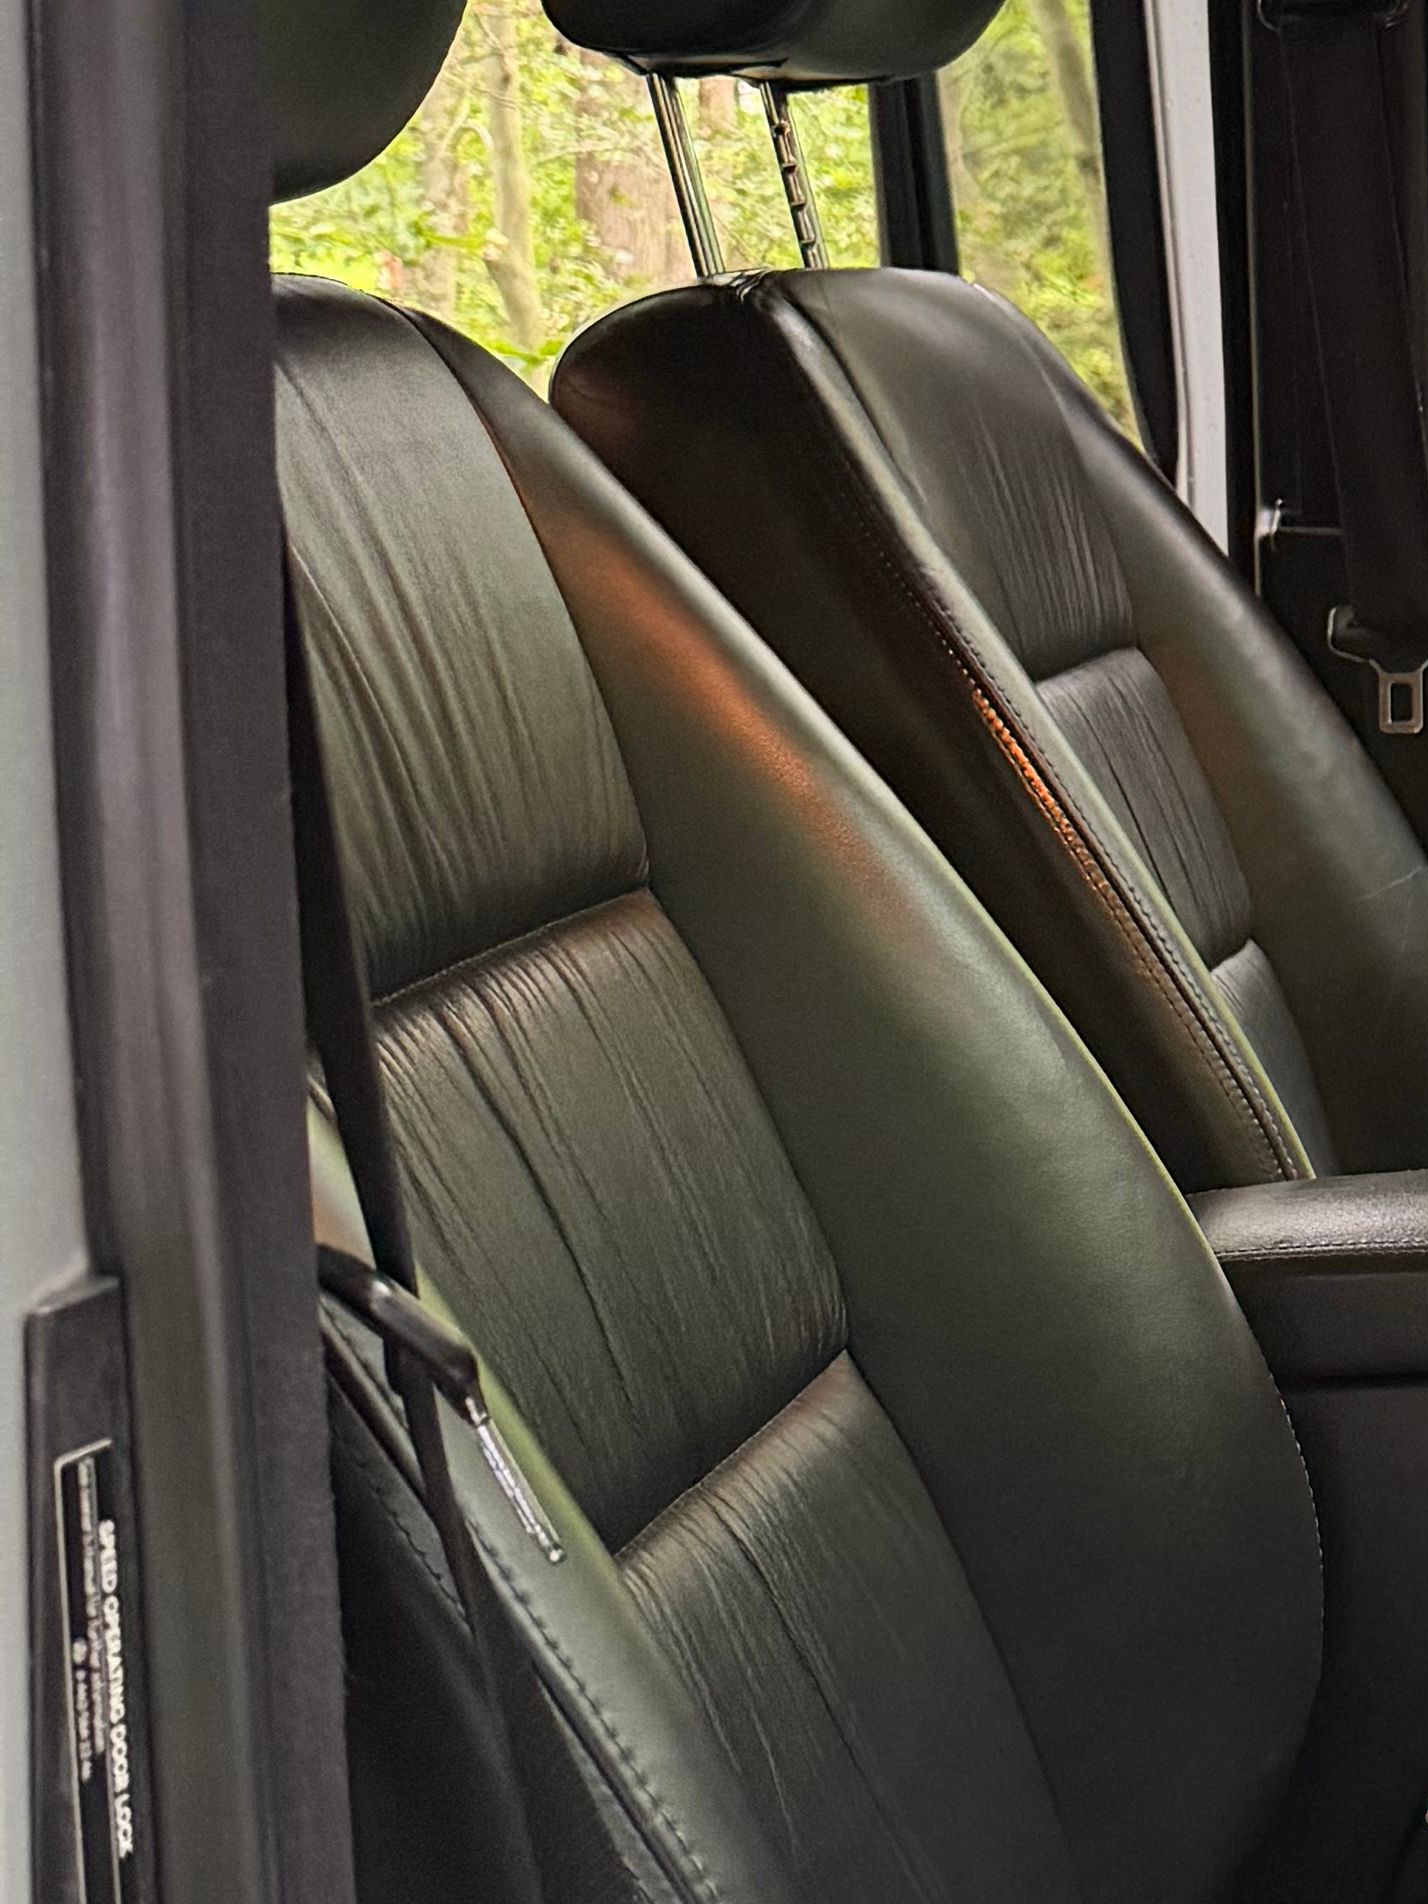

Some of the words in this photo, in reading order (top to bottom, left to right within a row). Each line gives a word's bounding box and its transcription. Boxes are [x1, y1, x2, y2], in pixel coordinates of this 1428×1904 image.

[99, 1519, 117, 1594] SPEED
[103, 1595, 124, 1723] OPERATING
[111, 1724, 129, 1793] DOOR
[115, 1793, 133, 1859] LOCK
